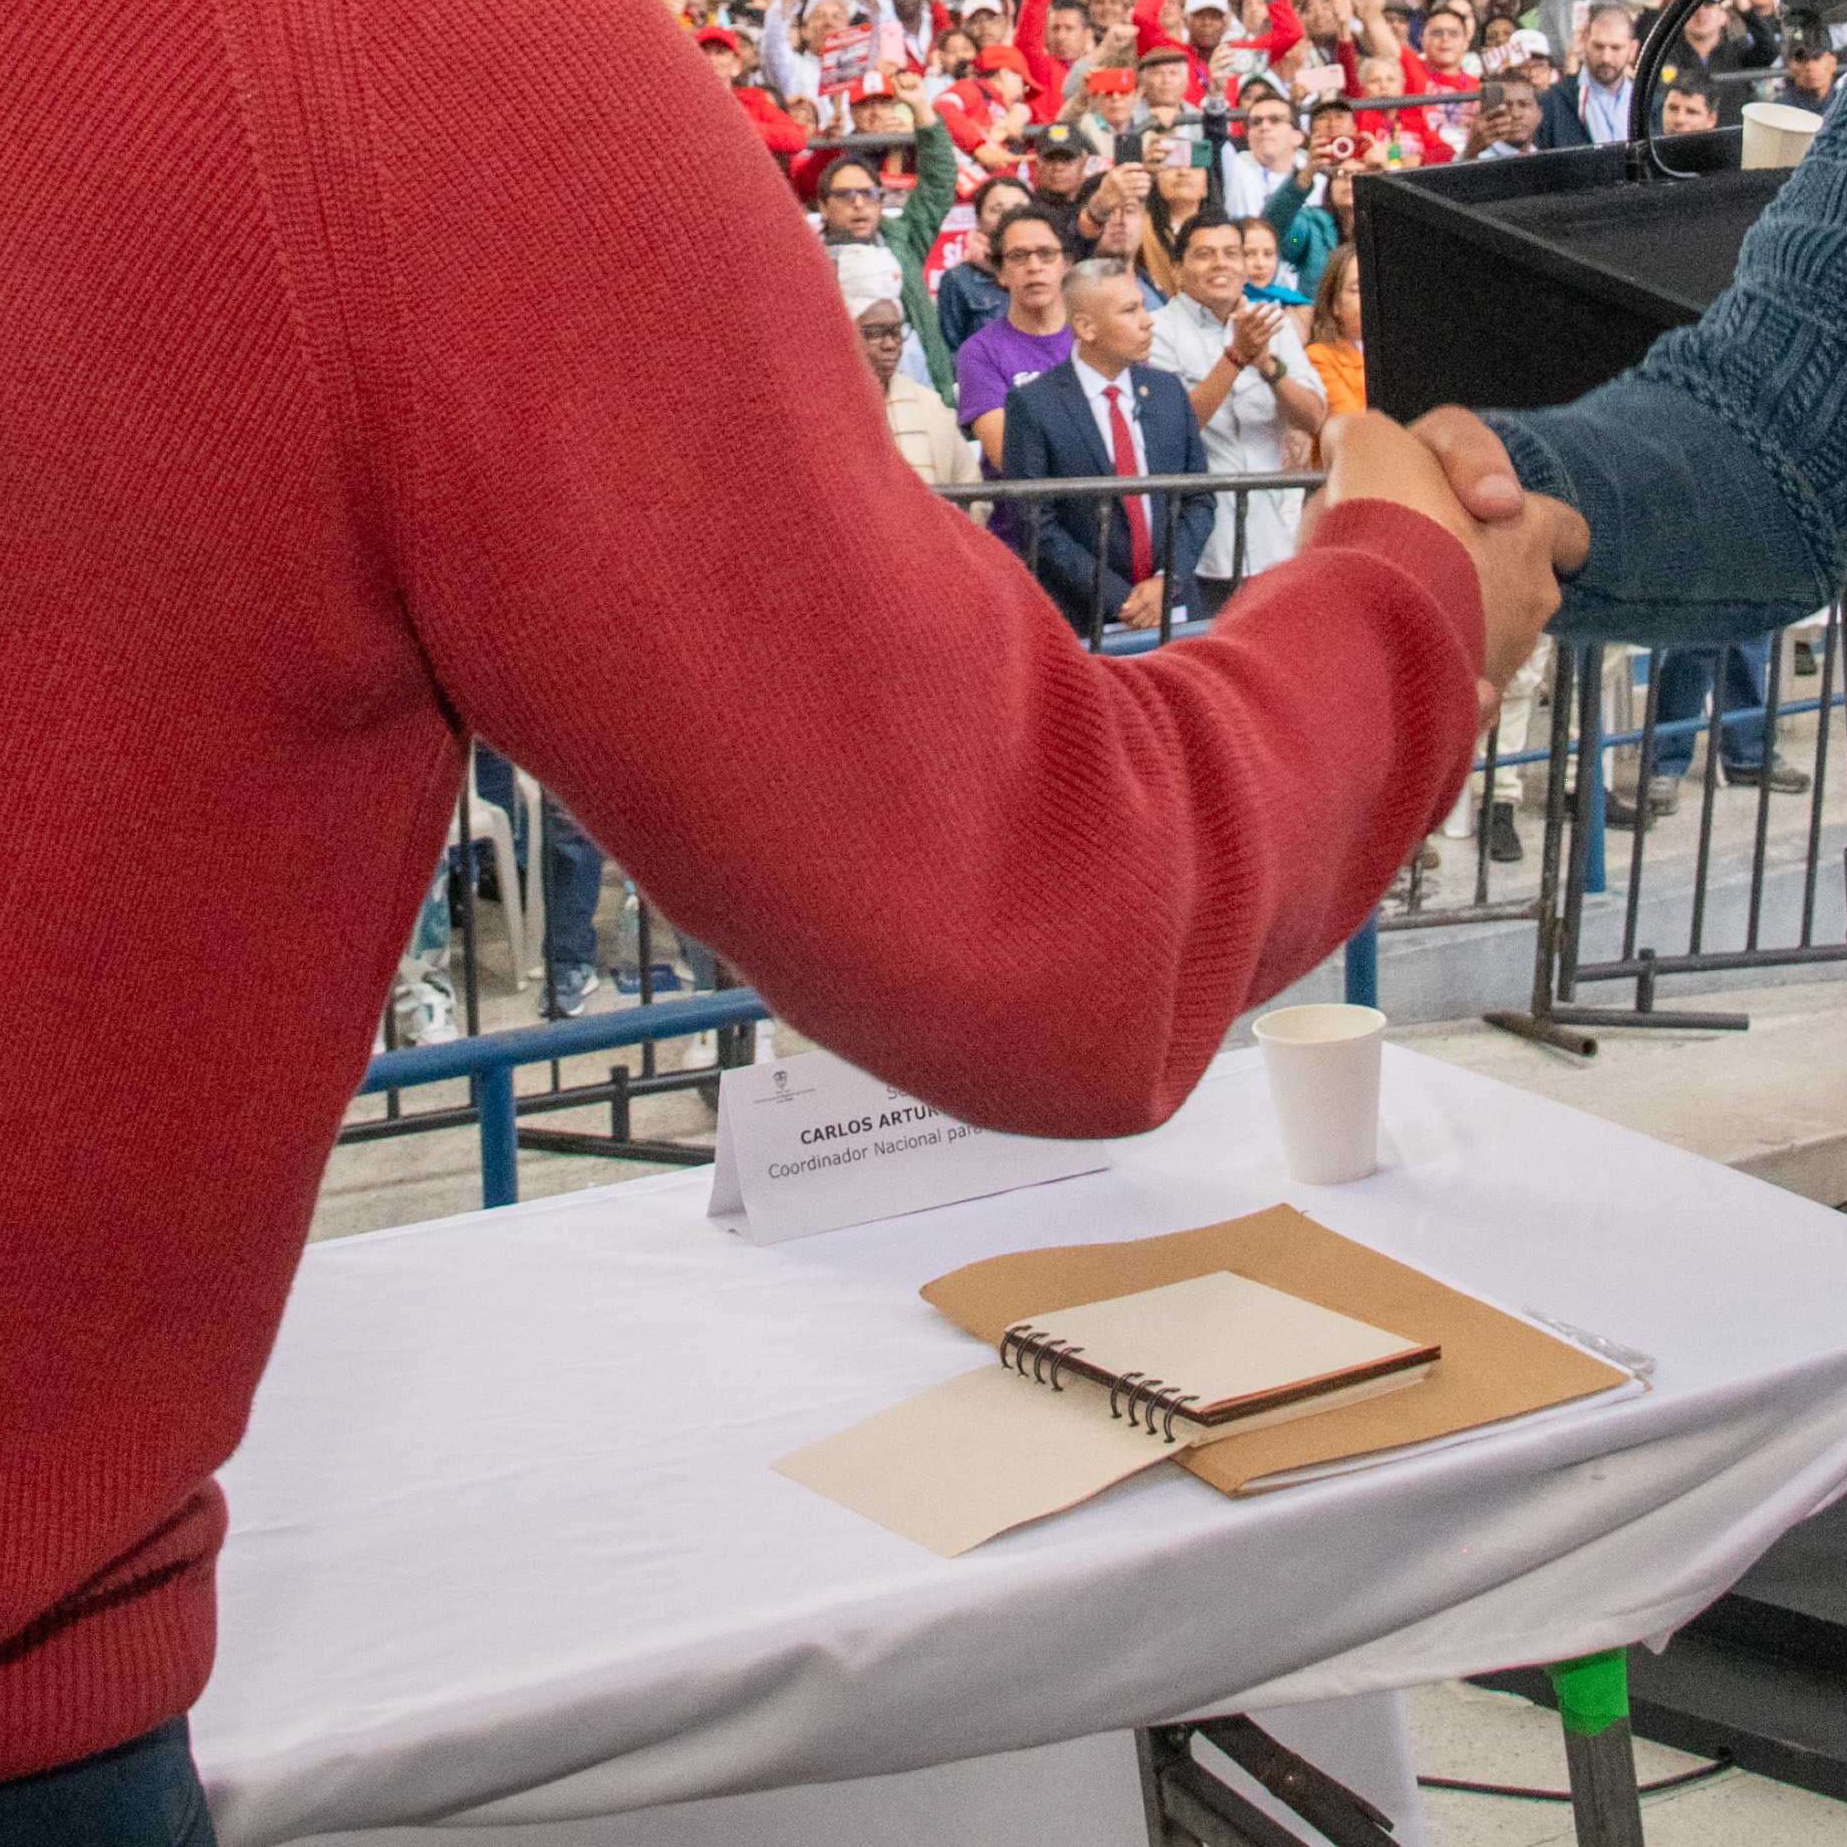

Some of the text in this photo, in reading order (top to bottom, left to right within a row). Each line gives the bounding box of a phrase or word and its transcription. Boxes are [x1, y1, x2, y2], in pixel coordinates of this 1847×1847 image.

[800, 1116, 873, 1145] CARLOS
[768, 1147, 868, 1180] Coordinador
[874, 1128, 942, 1155] Nacional
